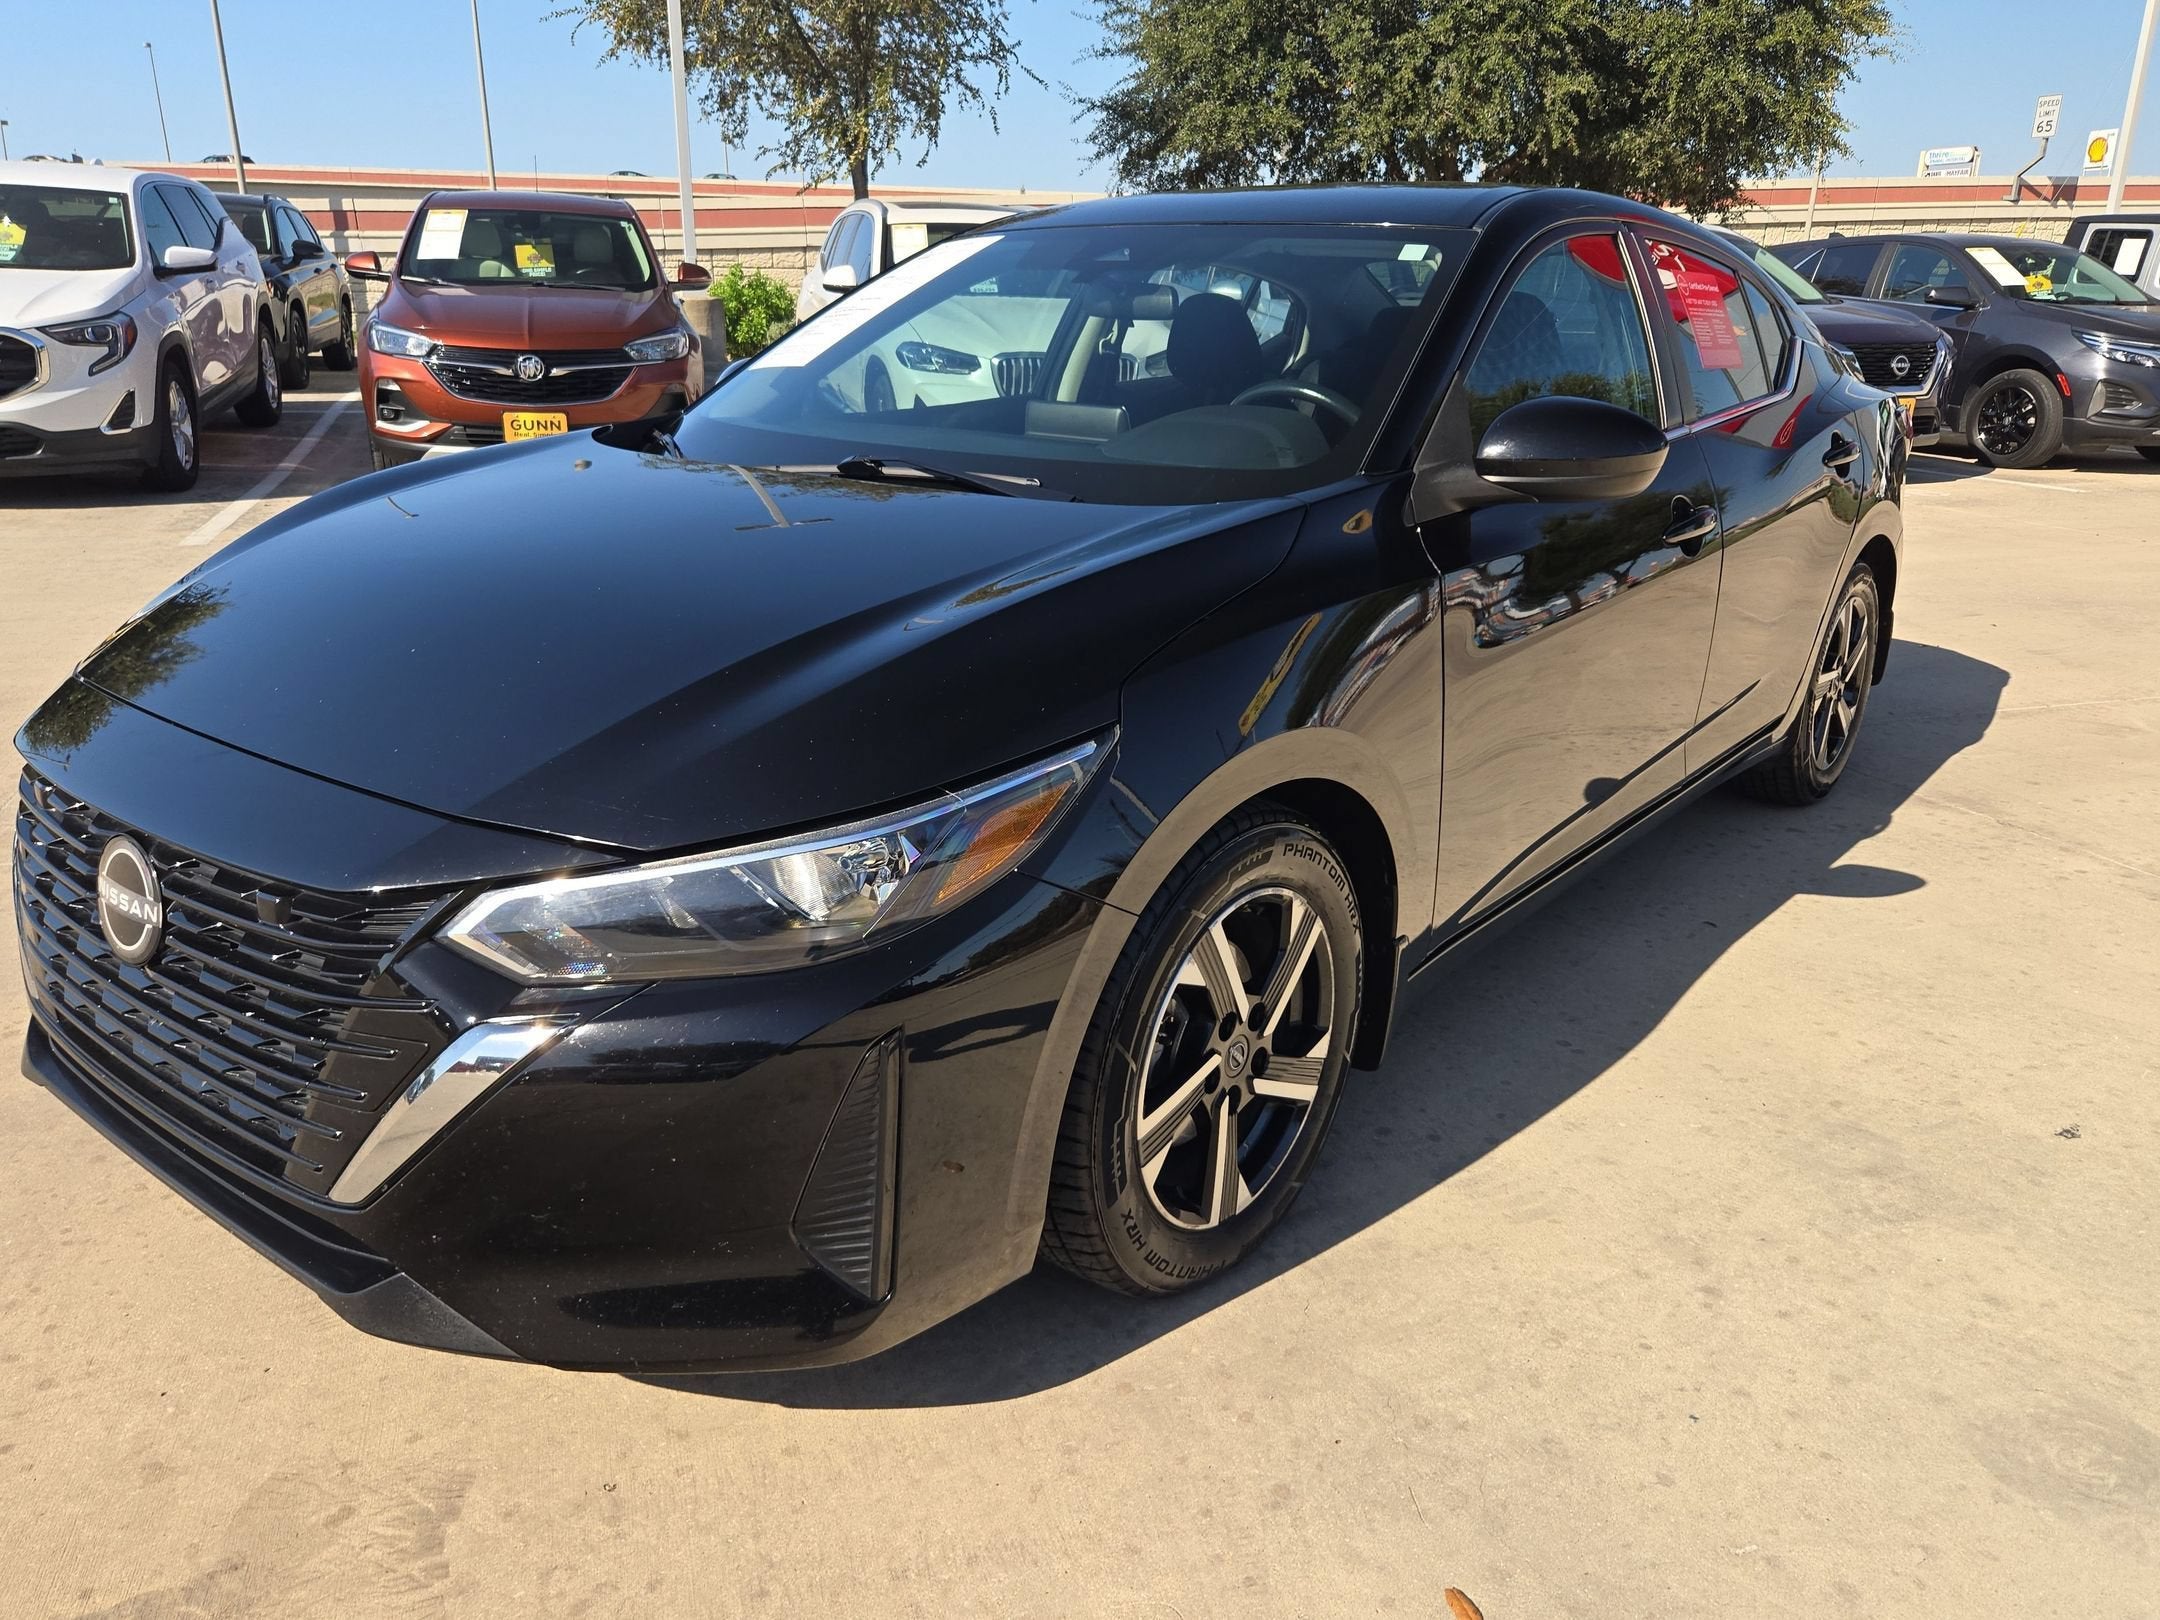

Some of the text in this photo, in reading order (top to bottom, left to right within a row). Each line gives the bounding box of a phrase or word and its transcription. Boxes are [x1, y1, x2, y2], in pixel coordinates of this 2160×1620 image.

[2039, 99, 2060, 107] SPEED
[2038, 109, 2056, 118] LIMIT
[2036, 119, 2053, 133] 65
[510, 419, 562, 431] GUNN
[1283, 843, 1361, 934] PHANTOM HRX
[98, 876, 158, 922] NISSAN
[1120, 1208, 1147, 1251] HRX
